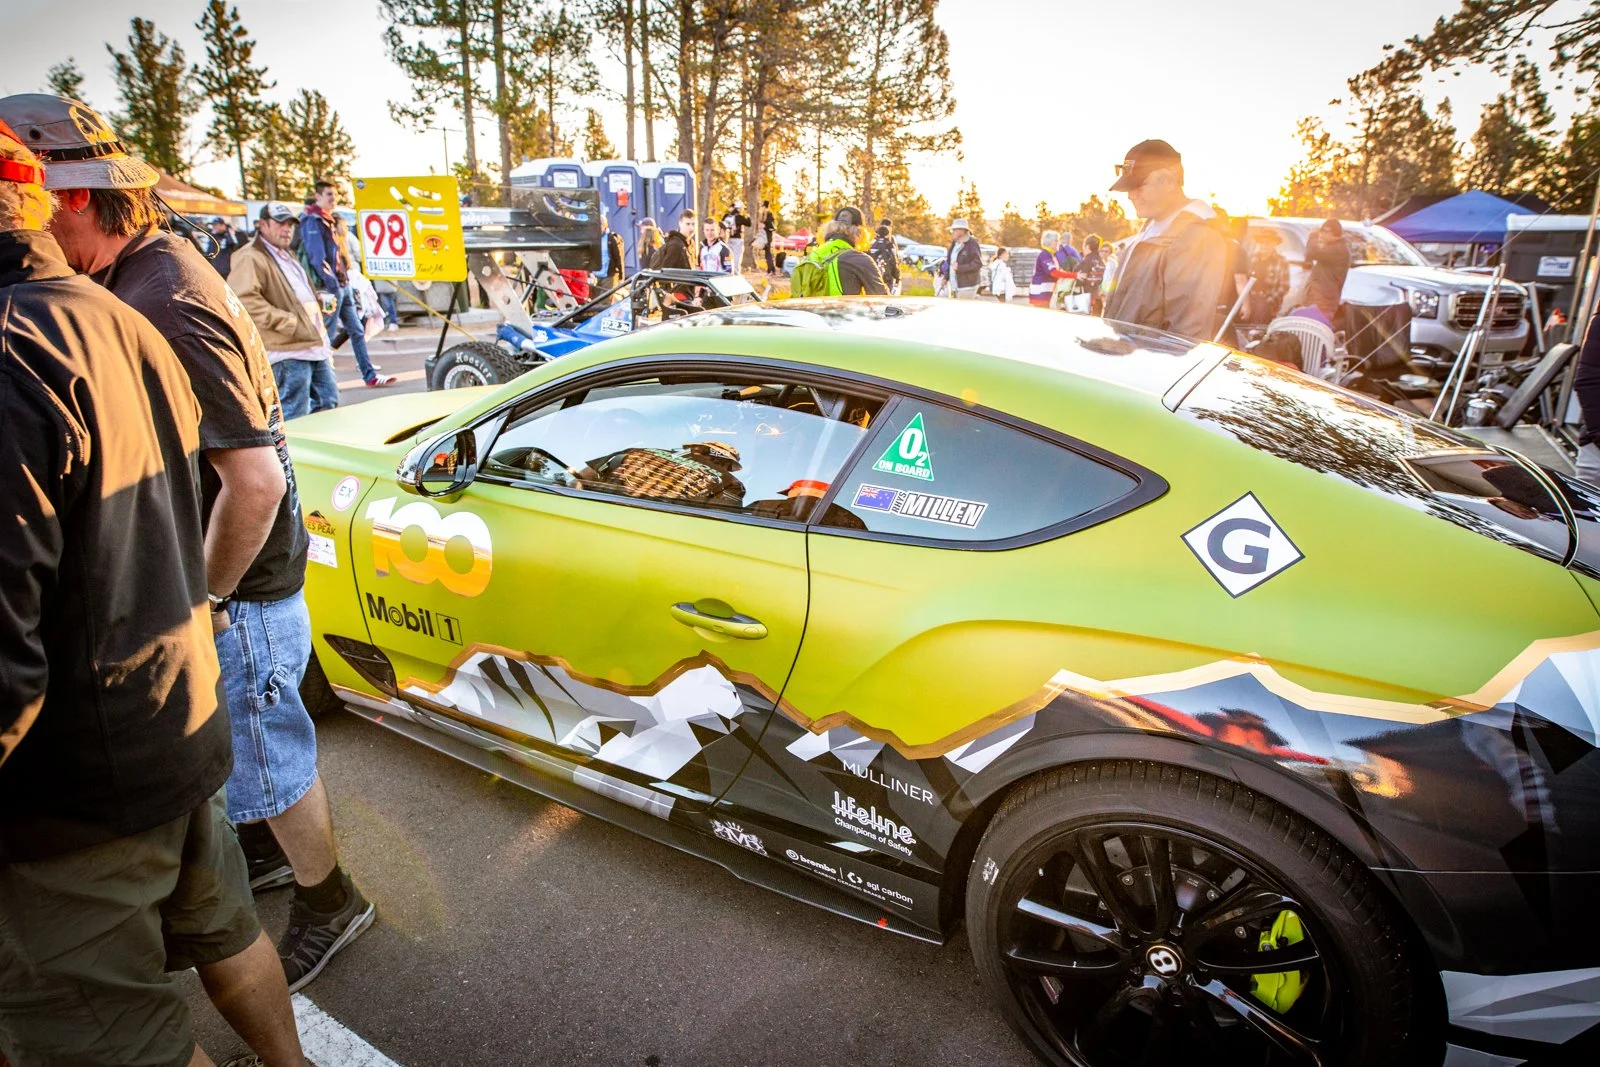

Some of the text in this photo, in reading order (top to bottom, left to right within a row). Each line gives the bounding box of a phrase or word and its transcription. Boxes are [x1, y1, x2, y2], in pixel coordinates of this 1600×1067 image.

[365, 214, 408, 256] 98
[455, 351, 492, 379] Hoosier
[879, 459, 931, 478] ON BOARD
[338, 486, 354, 498] EX
[891, 491, 907, 513] RHYS
[900, 493, 985, 527] MILLEN
[317, 523, 336, 536] PEAK
[364, 496, 493, 598] 100
[1207, 517, 1271, 575] G
[366, 592, 455, 641] Mobil 1
[843, 760, 933, 806] MULLINER
[834, 817, 913, 857] Champions of Safety
[800, 854, 914, 905] brembo sgl carbon
[813, 868, 886, 901] CARBON CERAMIC BRAKES
